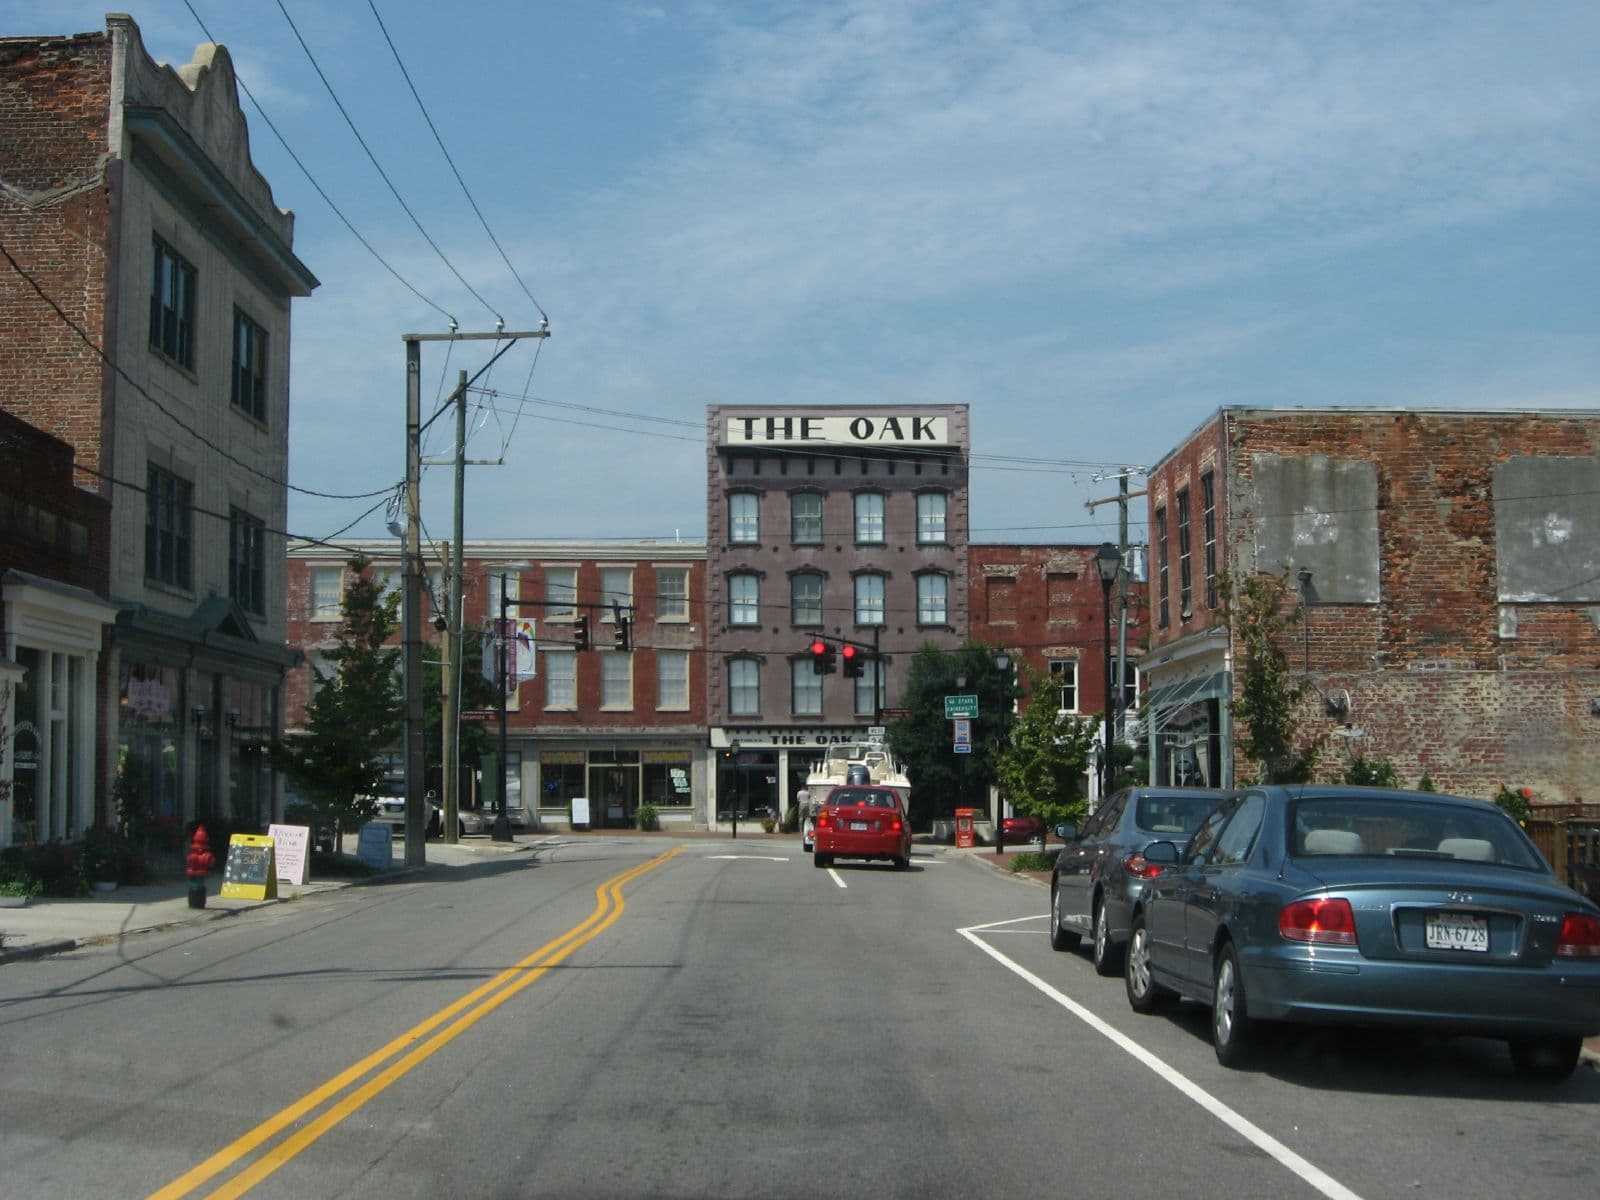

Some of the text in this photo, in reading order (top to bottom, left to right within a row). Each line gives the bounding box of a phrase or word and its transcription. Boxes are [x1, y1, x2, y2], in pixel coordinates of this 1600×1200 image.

[737, 417, 936, 440] THE OAK
[769, 735, 806, 745] THE
[815, 735, 853, 745] OAK
[1429, 924, 1486, 943] JRN-6728
